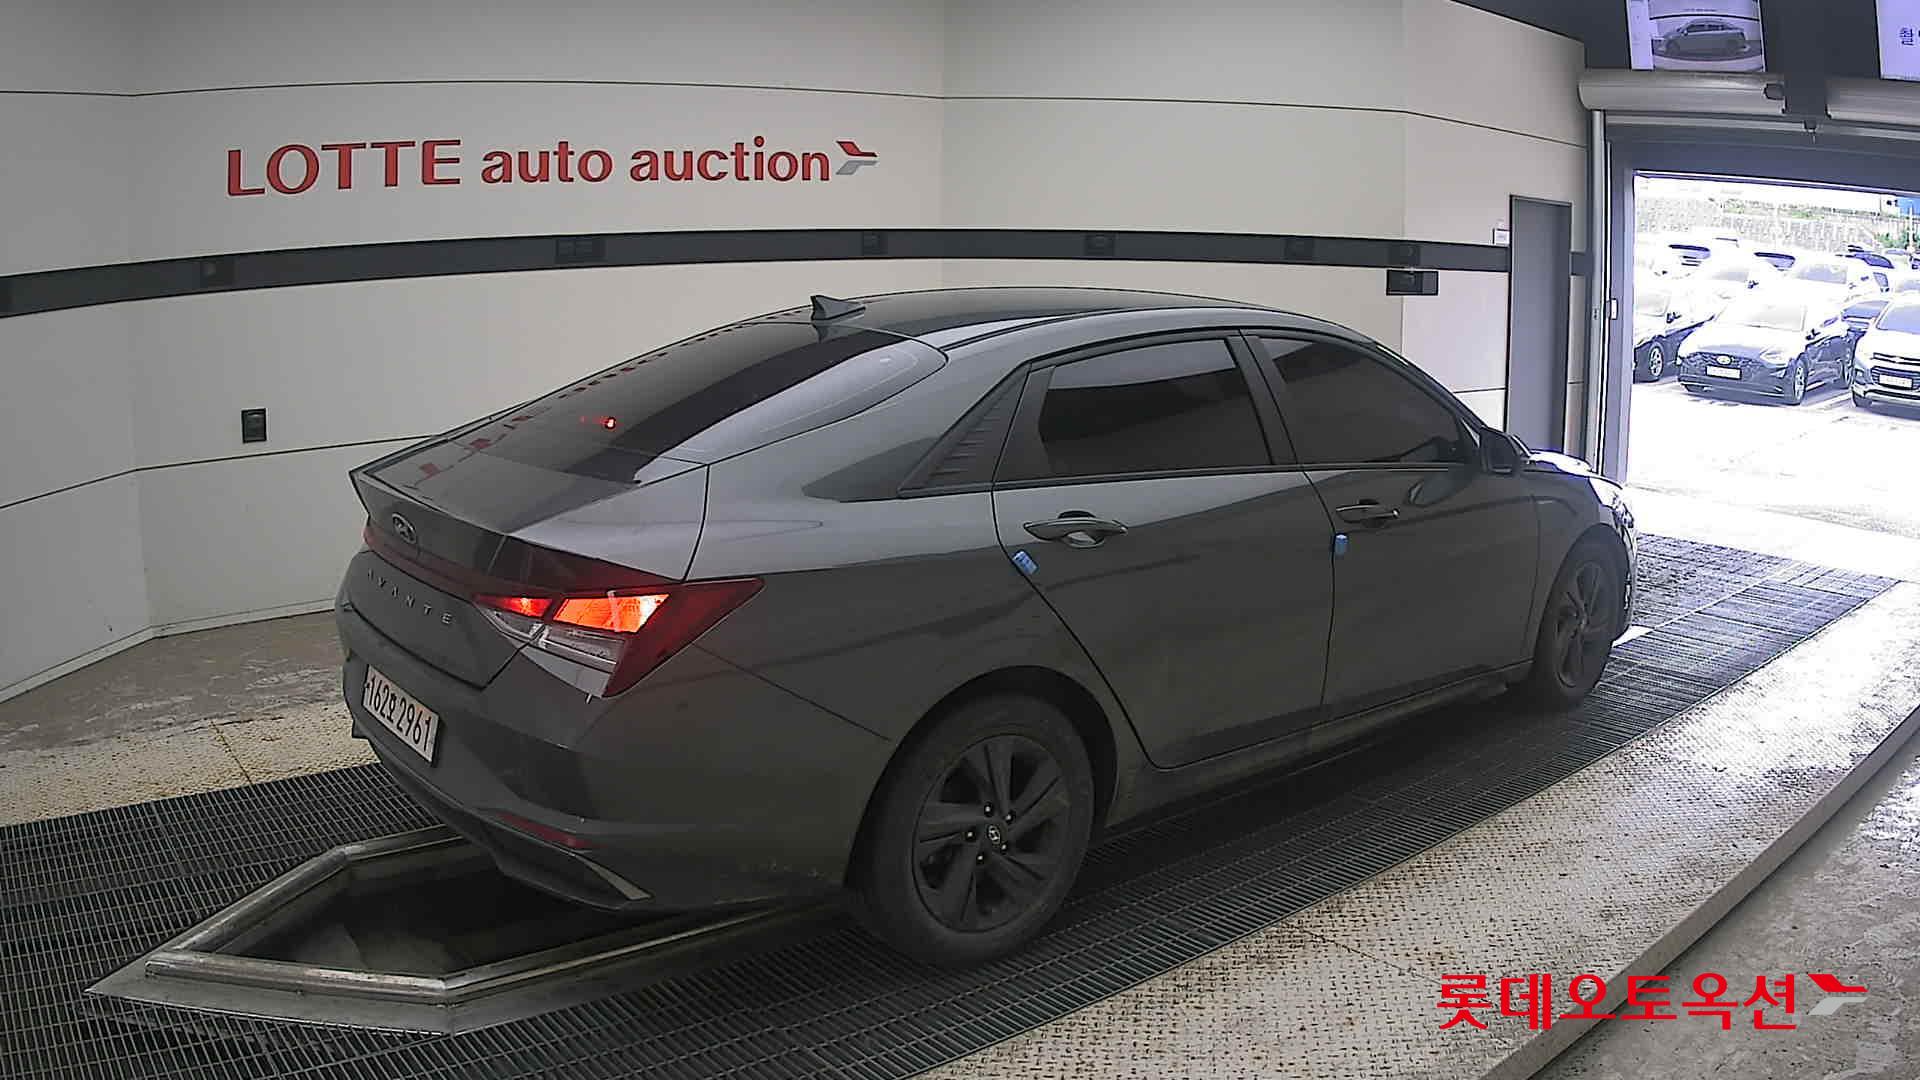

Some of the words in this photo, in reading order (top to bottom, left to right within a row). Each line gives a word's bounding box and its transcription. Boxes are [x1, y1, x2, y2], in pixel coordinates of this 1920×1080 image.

[227, 138, 461, 196] LOTTE
[481, 141, 612, 184] auto
[630, 135, 830, 182] auction
[366, 568, 455, 625] AVANTE
